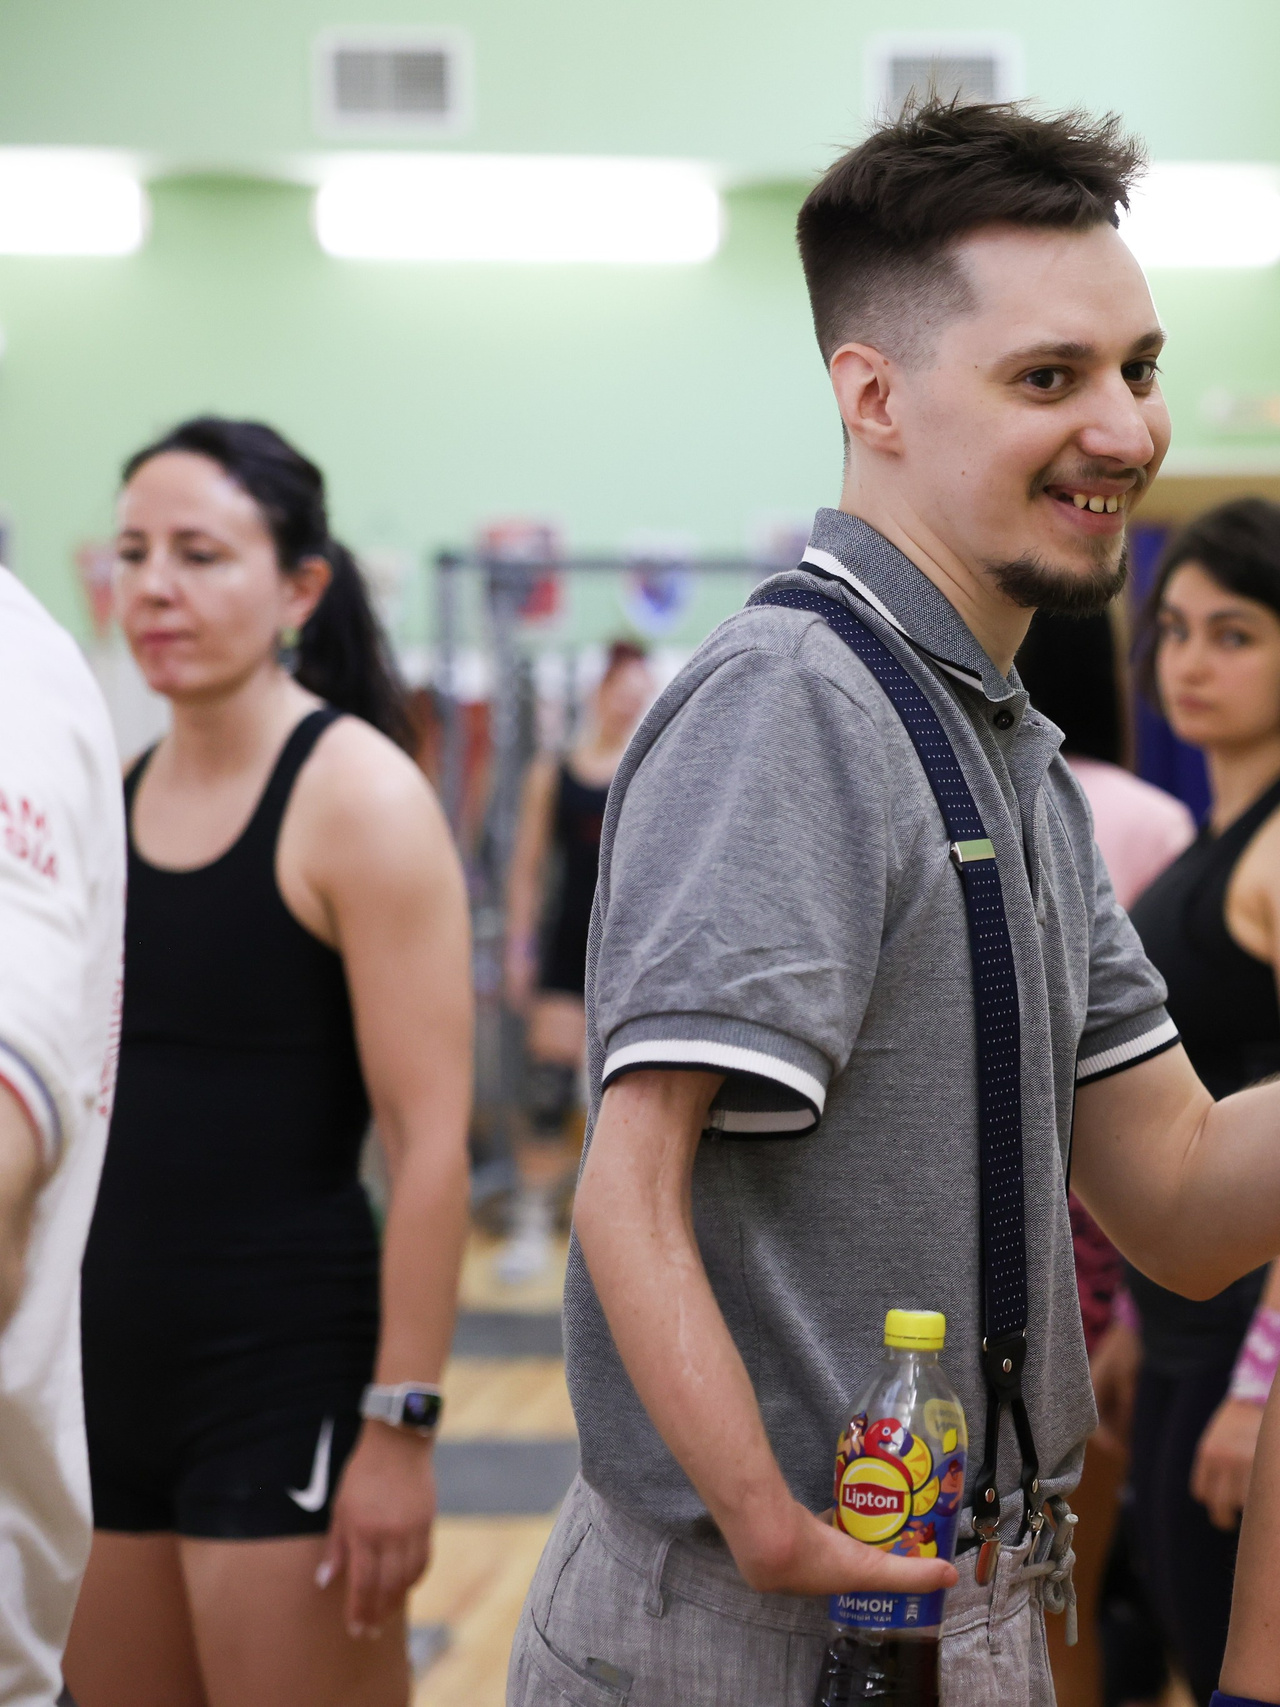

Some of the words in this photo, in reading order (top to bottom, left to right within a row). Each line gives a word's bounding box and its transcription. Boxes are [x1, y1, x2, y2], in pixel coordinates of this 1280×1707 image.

[845, 1488, 898, 1509] Lipton
[838, 1595, 893, 1613] ЛИМОН
[873, 1614, 892, 1622] ЧАЙ
